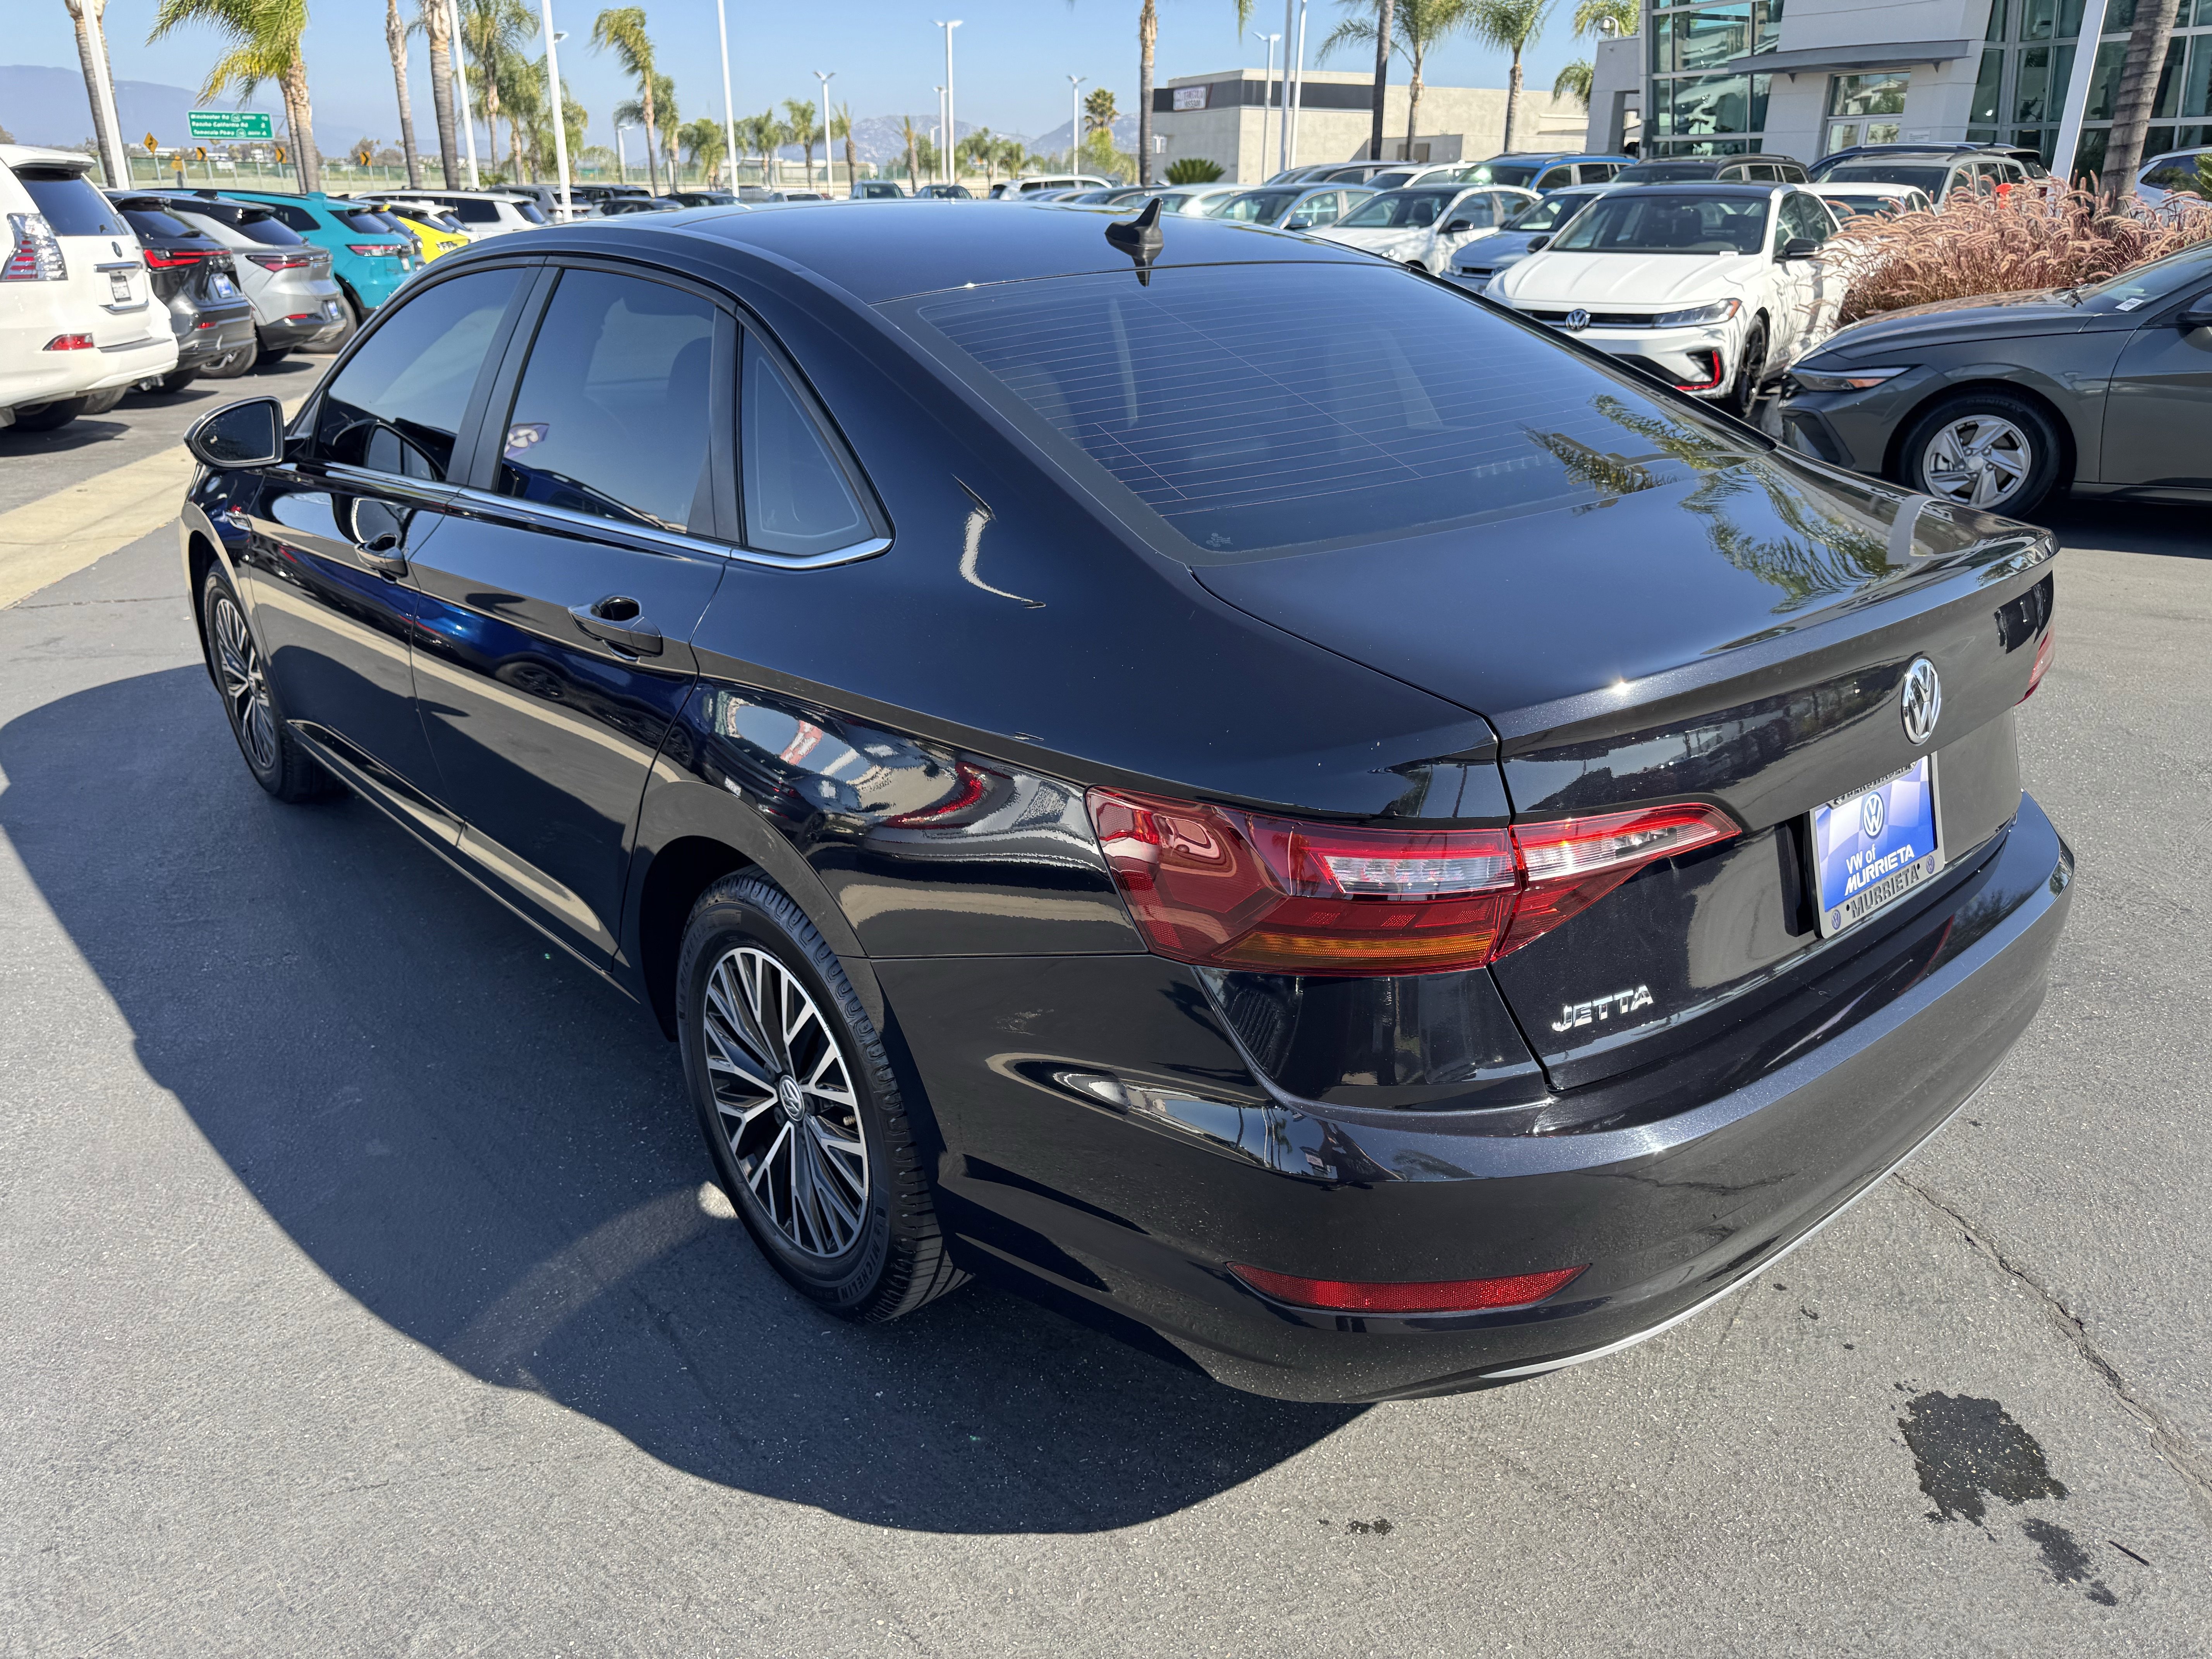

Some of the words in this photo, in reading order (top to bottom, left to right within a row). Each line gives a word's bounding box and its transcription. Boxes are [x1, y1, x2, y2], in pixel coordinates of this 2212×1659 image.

[1863, 793, 1884, 836] VW
[1844, 844, 1915, 896] MURRIETA
[1846, 851, 1862, 874] VW
[1866, 843, 1875, 863] of
[1850, 864, 1919, 919] MURRIETA
[1551, 984, 1654, 1032] JETTA
[840, 1240, 881, 1299] MICHELIN
